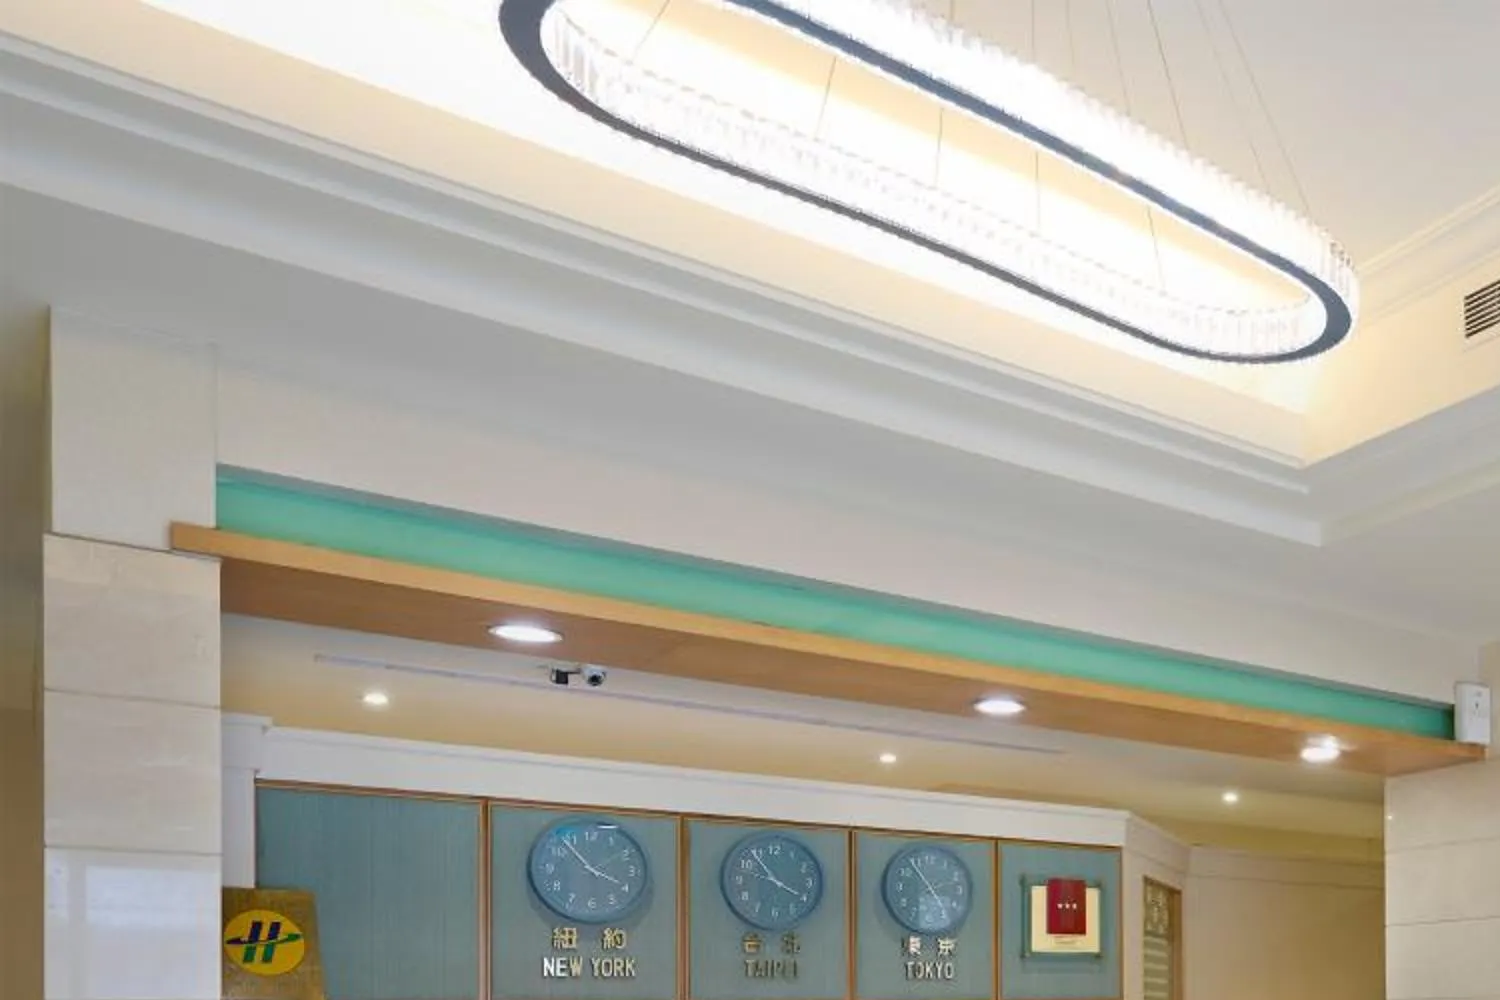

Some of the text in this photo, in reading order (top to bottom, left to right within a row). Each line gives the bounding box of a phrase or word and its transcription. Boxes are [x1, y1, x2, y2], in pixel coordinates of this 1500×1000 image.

[542, 955, 636, 977] NEW YORK
[905, 960, 955, 980] TOKYO
